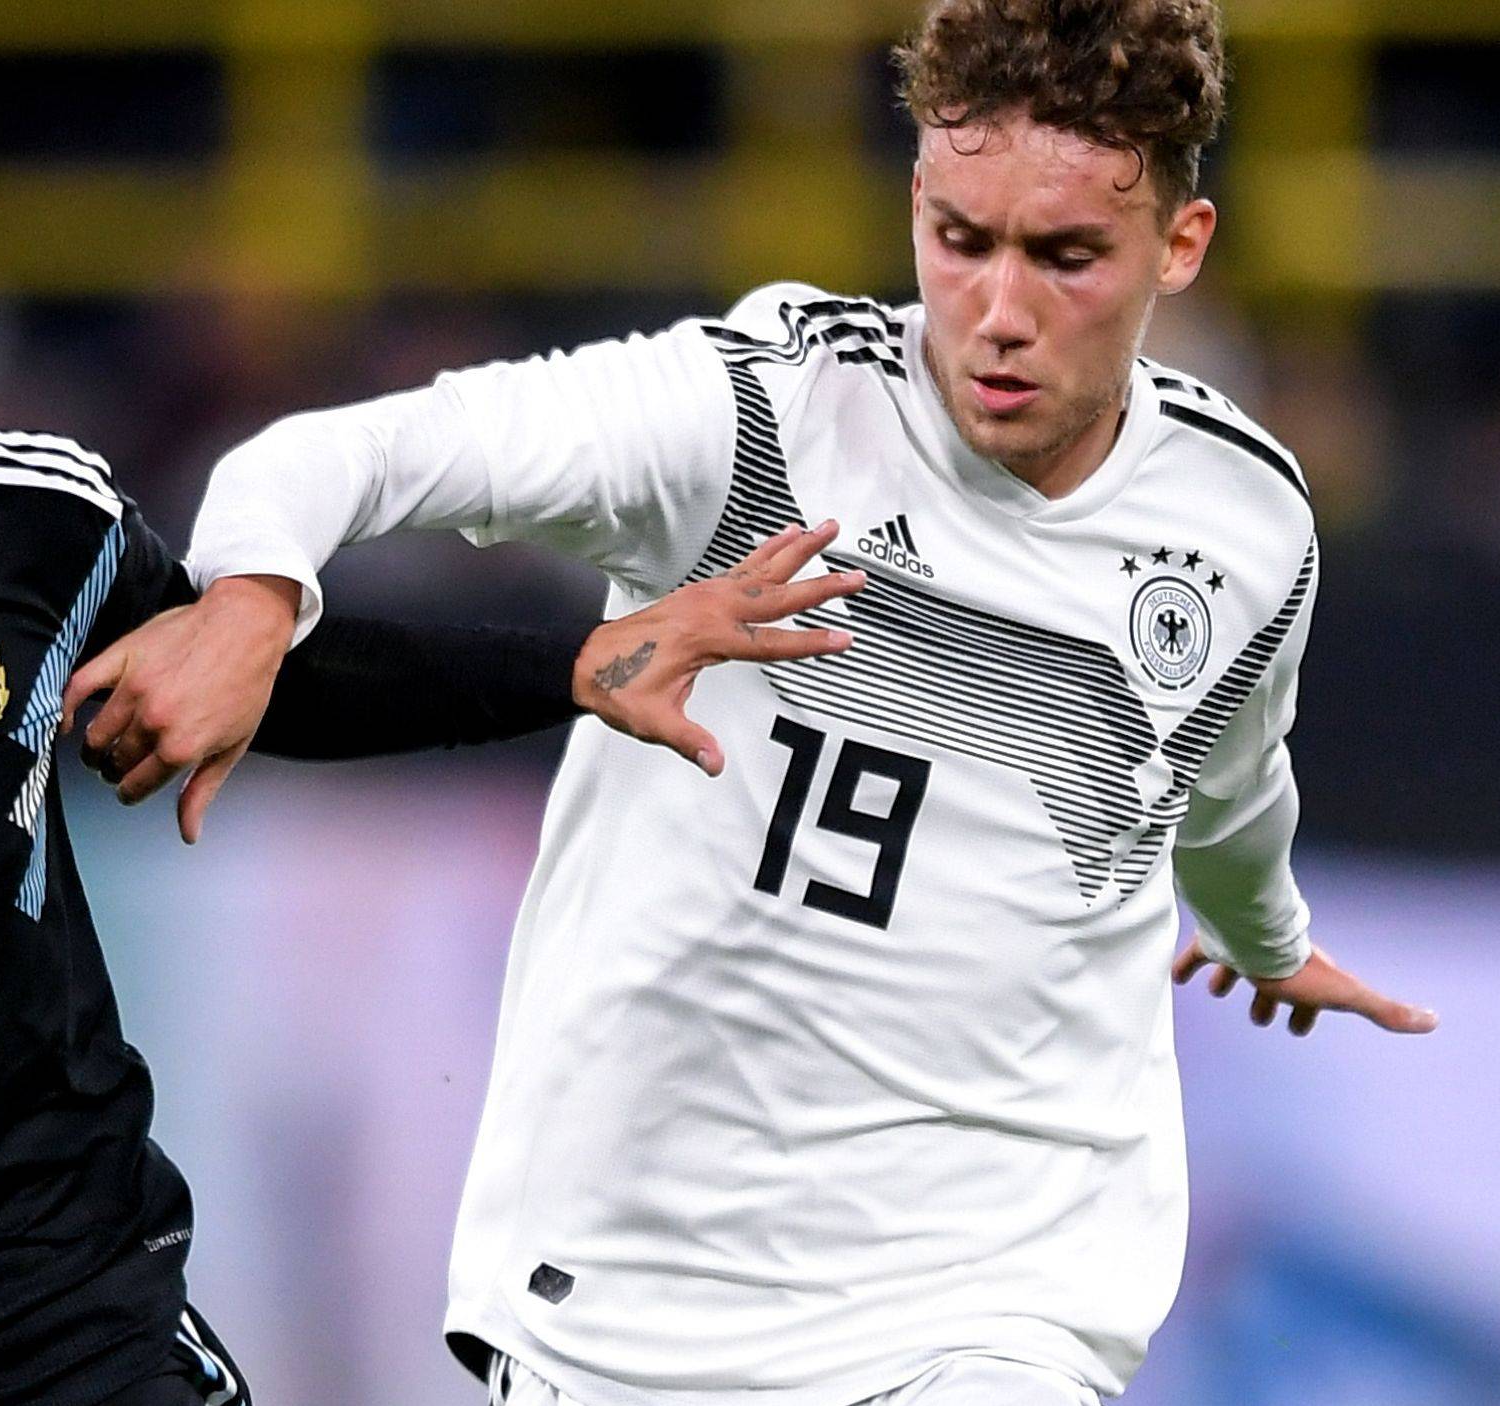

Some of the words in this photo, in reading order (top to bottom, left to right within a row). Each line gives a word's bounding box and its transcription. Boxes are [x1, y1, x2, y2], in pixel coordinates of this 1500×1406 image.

[857, 537, 935, 579] adidas
[1147, 591, 1197, 615] DEUTSCHER
[753, 714, 933, 931] 19
